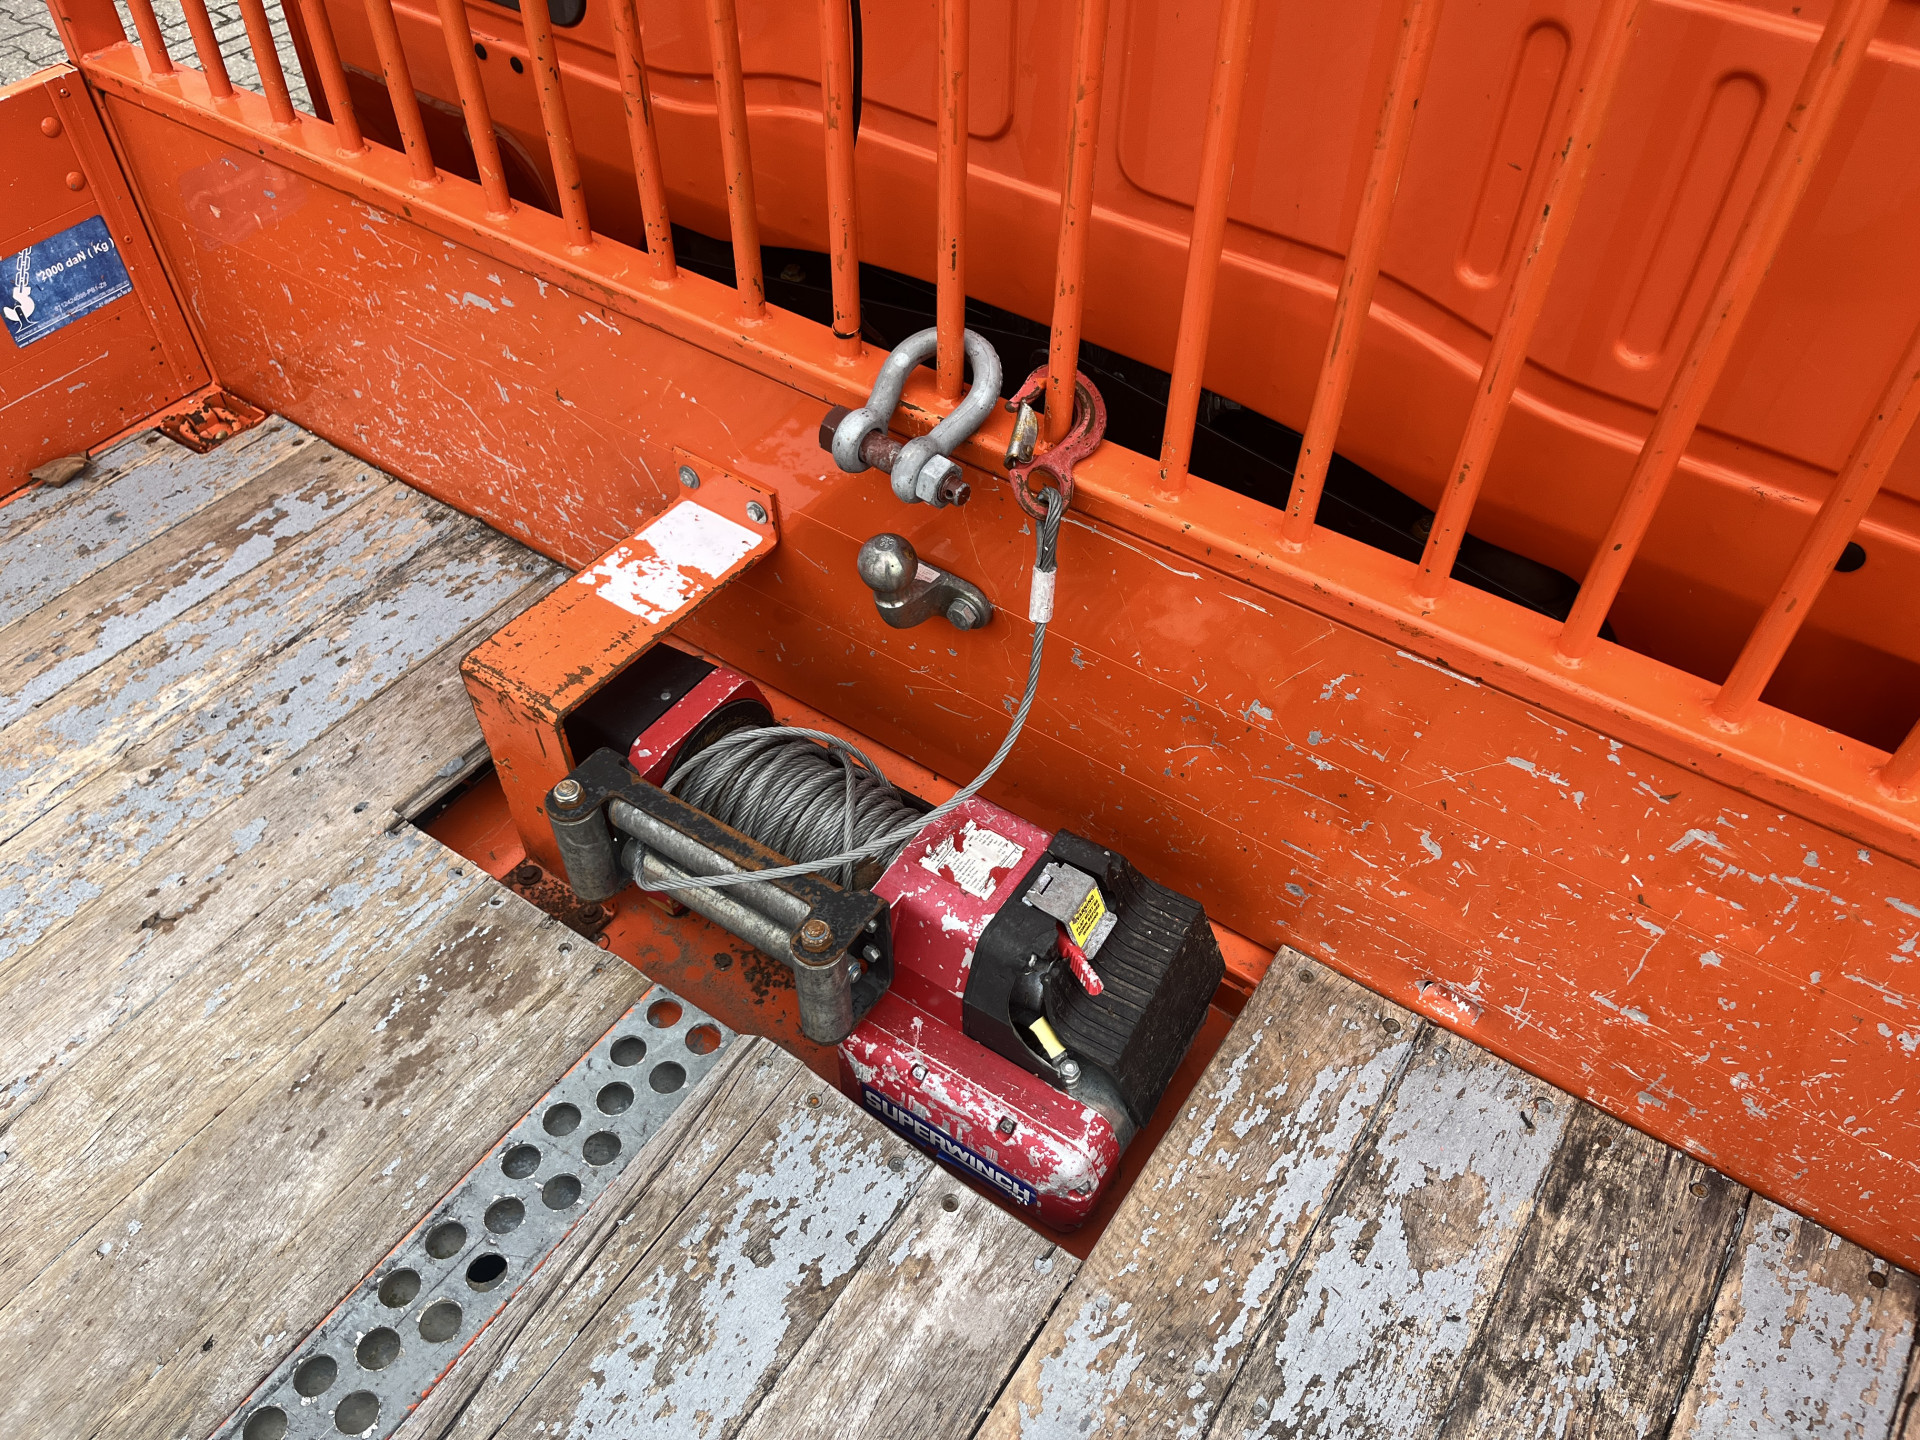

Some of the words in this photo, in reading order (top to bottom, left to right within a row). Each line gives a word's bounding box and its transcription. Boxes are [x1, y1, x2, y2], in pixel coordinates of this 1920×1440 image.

[39, 262, 64, 281] 2000
[65, 249, 87, 268] daN
[92, 241, 110, 254] Kg
[1076, 919, 1085, 933] FLAP
[1077, 921, 1088, 937] DOWN
[1087, 902, 1101, 922] BEFORE
[865, 1090, 1031, 1202] SUPERWINCH
